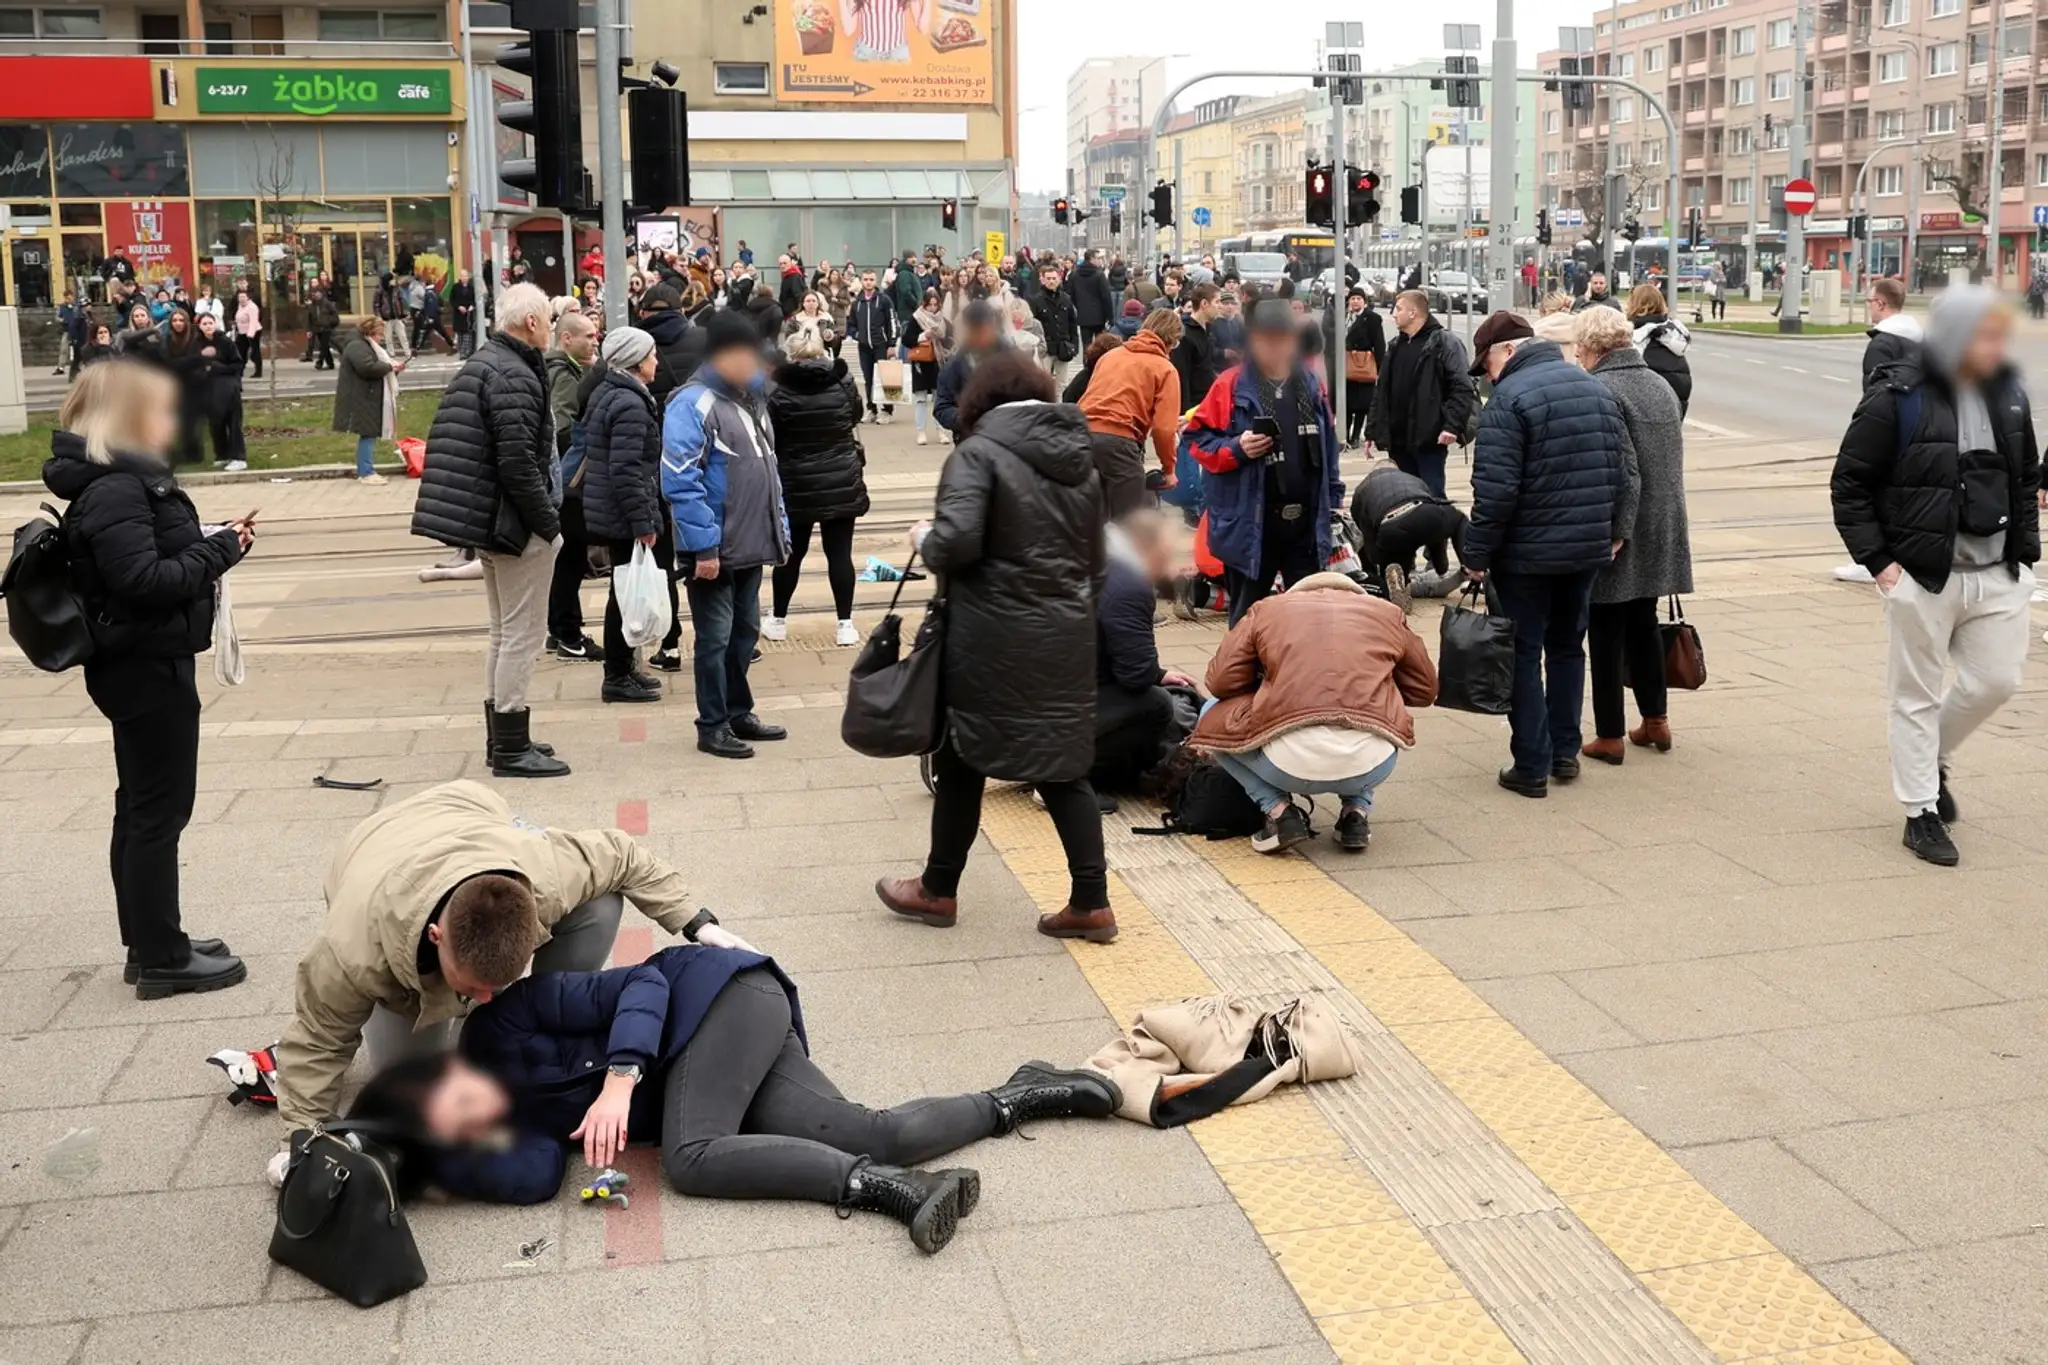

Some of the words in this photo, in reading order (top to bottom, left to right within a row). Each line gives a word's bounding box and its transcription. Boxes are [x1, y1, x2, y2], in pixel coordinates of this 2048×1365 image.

[792, 63, 807, 72] TU
[926, 62, 971, 74] Dostawa
[880, 74, 986, 87] www.kebabking.pl
[207, 84, 248, 96] 6-23/7
[272, 74, 378, 102] żabka
[912, 88, 927, 98] 22
[930, 88, 951, 98] 316
[954, 89, 968, 99] 37
[971, 89, 986, 99] 37
[1497, 223, 1512, 233] 37
